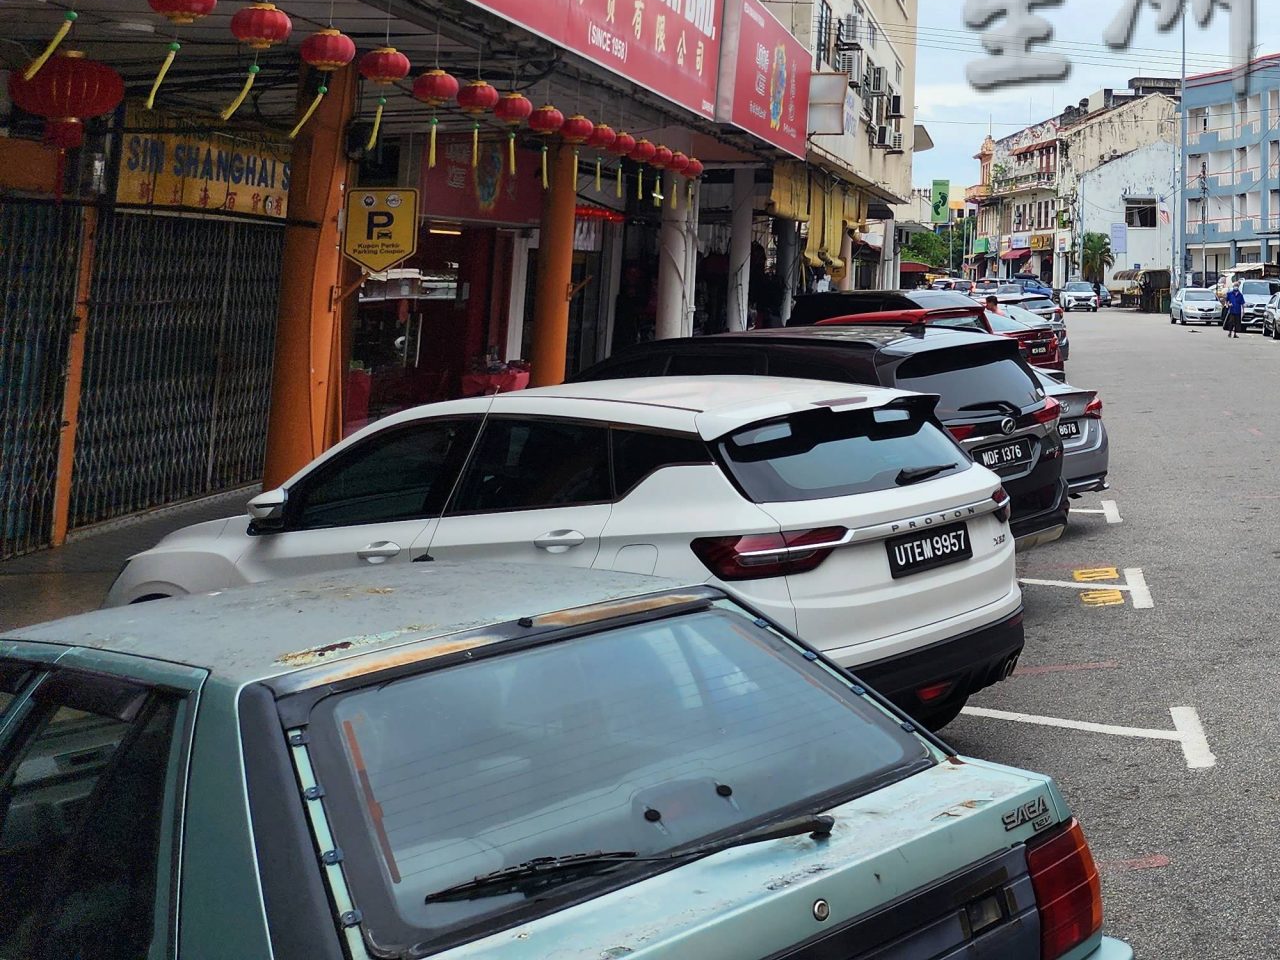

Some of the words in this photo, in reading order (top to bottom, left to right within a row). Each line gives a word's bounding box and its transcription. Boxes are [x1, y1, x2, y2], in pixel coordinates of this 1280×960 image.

[127, 134, 166, 175] SIN
[173, 143, 276, 190] SHANGHAI
[366, 211, 395, 241] P
[357, 242, 380, 250] Kupon
[981, 449, 1000, 466] MDF
[1001, 444, 1022, 462] 1376
[891, 507, 975, 533] PROTON
[1001, 795, 1050, 833] SAGA
